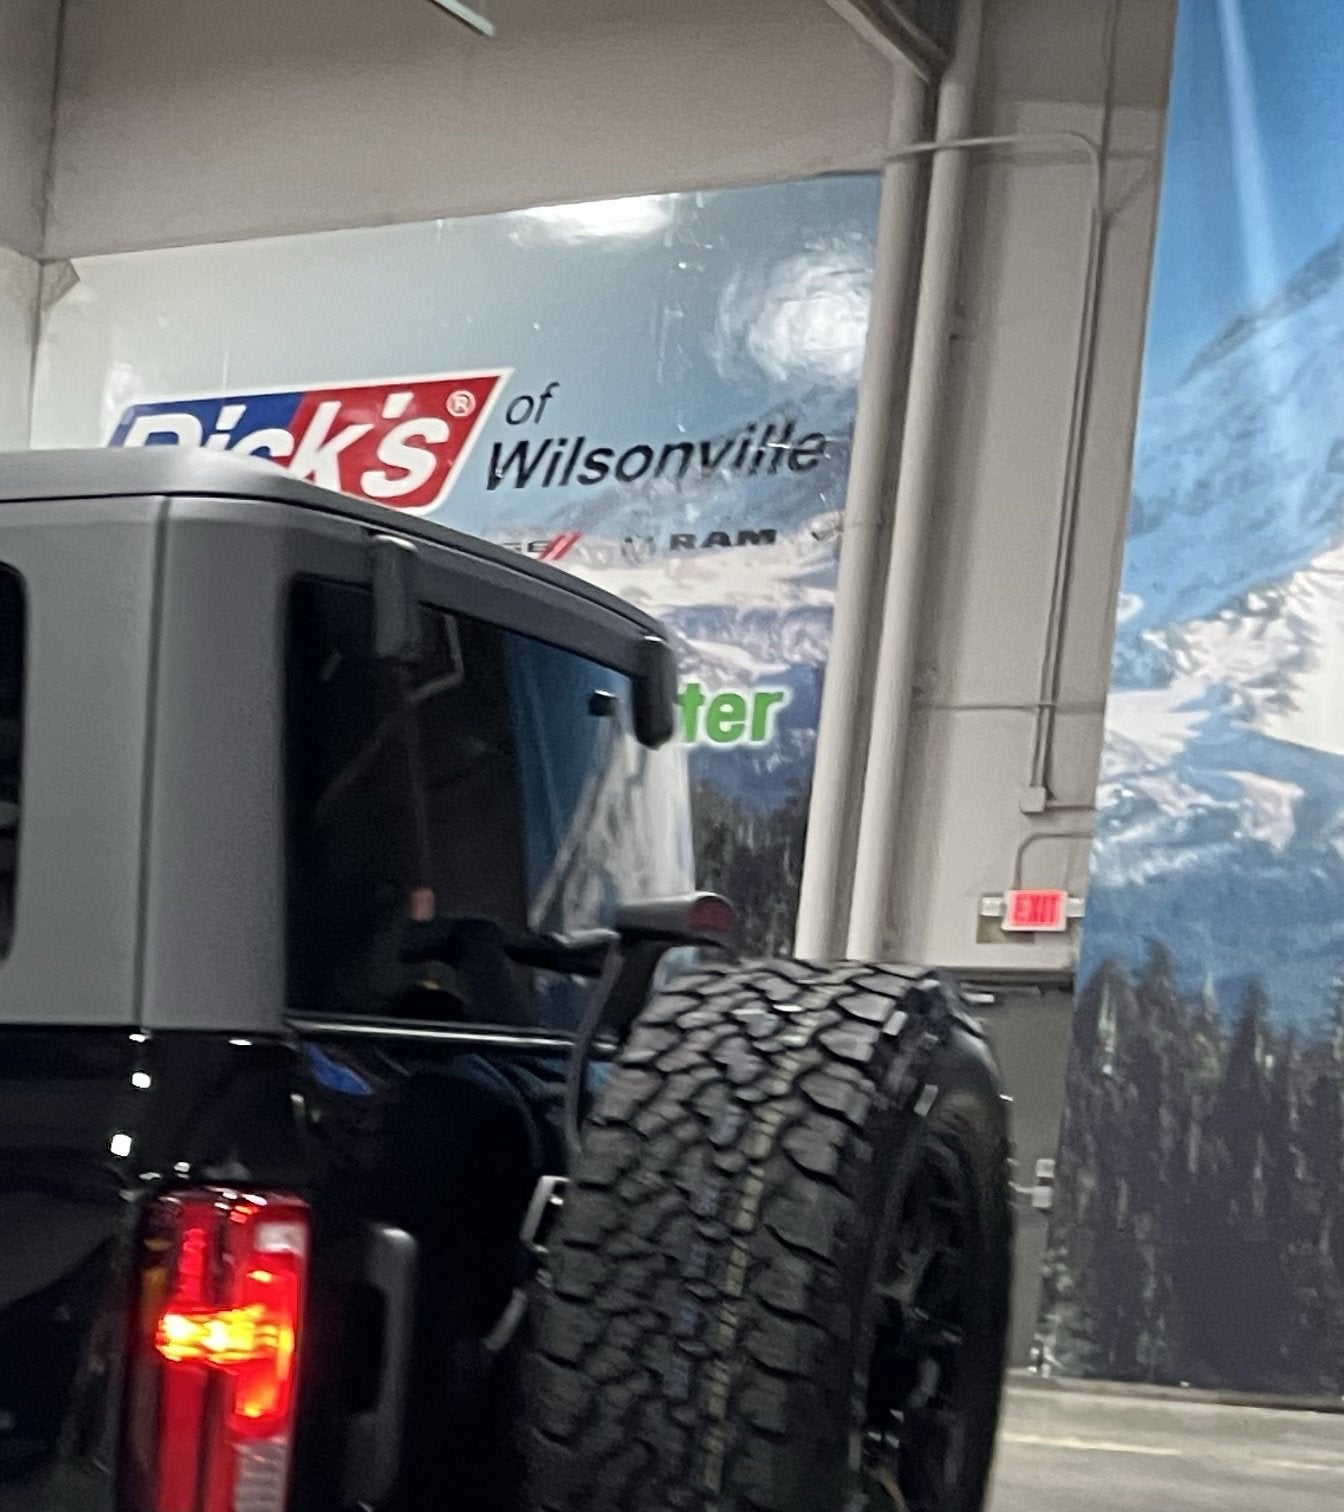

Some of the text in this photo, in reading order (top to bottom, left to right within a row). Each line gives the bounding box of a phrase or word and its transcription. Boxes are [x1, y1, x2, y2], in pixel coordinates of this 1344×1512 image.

[505, 381, 560, 425] of
[486, 418, 827, 491] Wilsonville
[669, 528, 778, 550] RAM
[1013, 892, 1060, 923] EXIT
